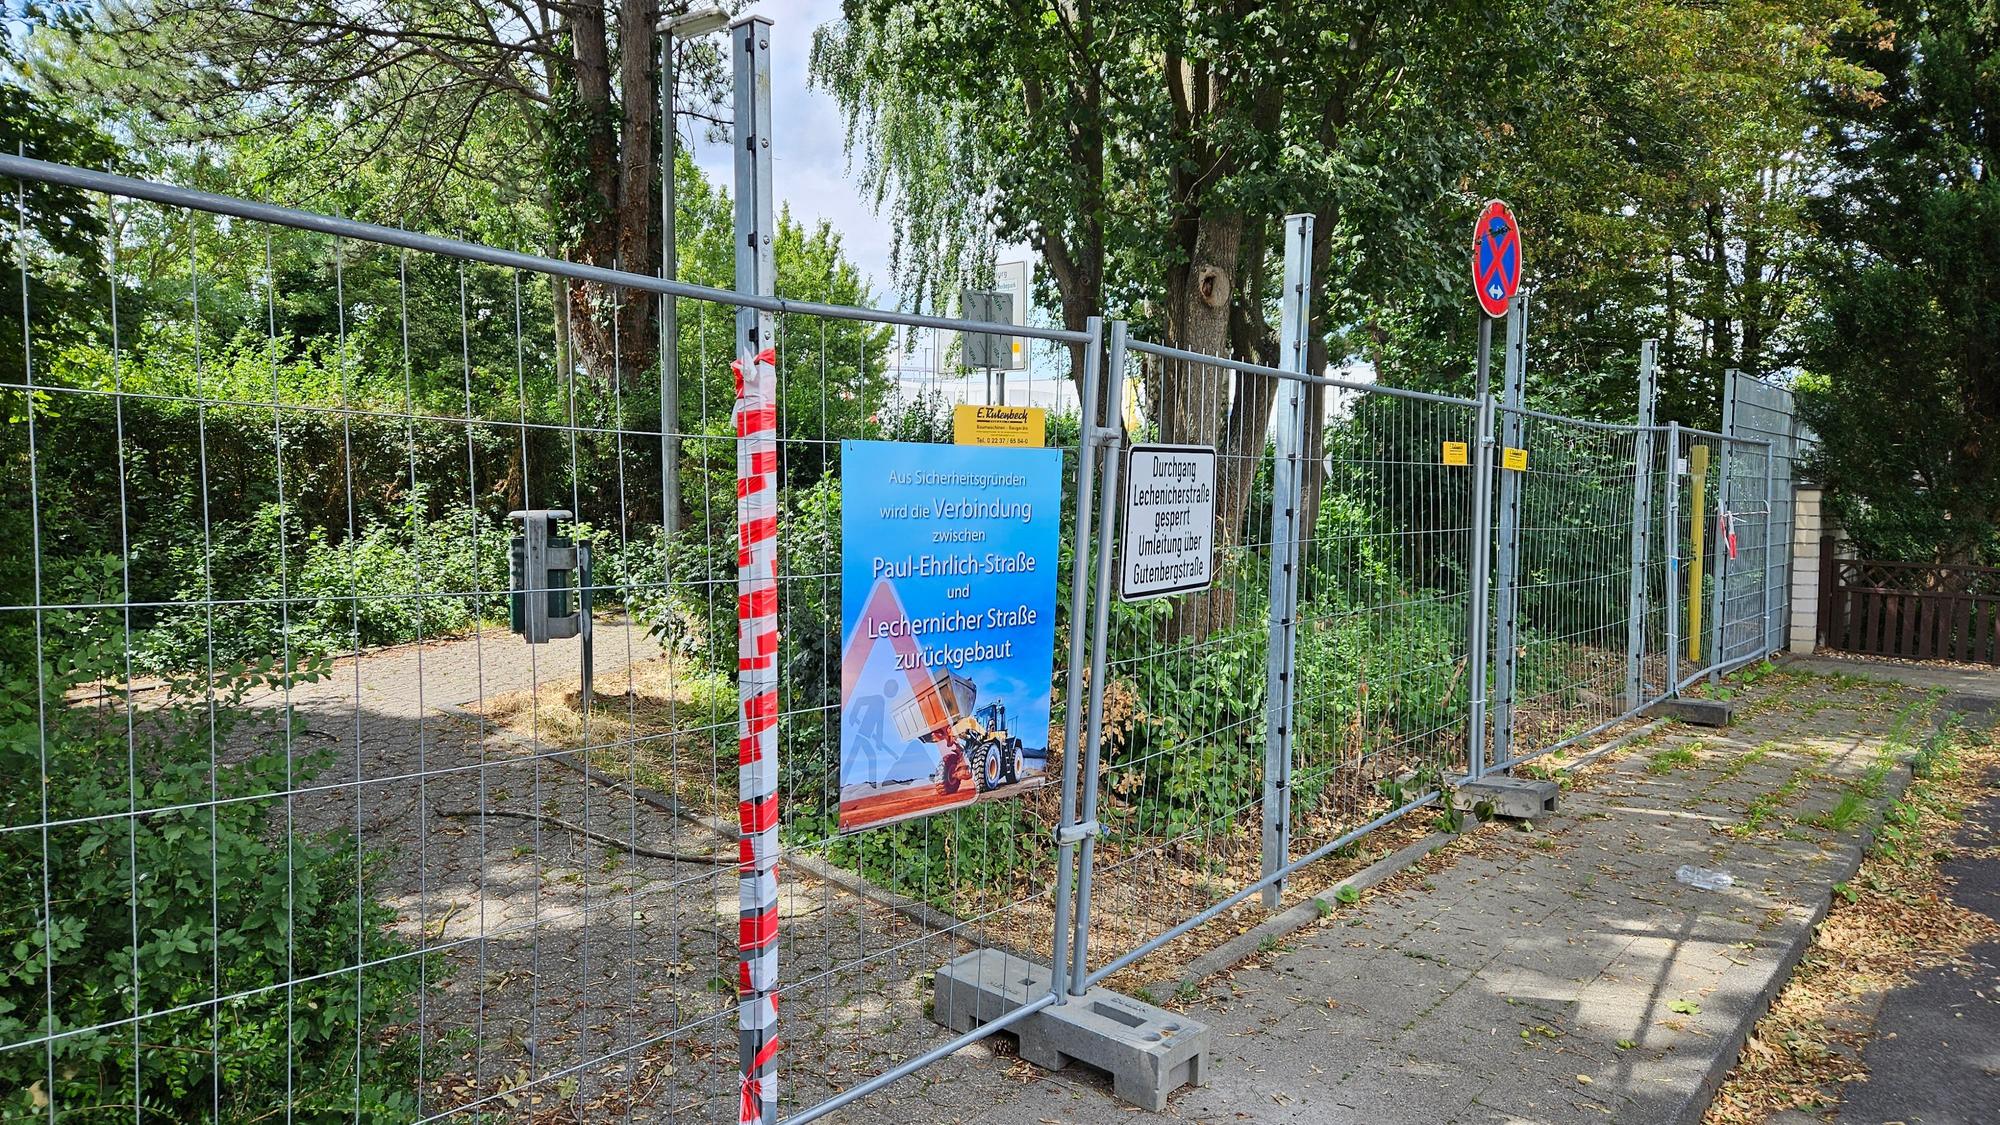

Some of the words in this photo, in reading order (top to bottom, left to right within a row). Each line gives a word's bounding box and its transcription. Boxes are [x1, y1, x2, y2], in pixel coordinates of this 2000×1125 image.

[986, 407, 1028, 423] Rutenbeck
[889, 470, 912, 485] Aus
[915, 470, 1026, 489] Sicherheitsgründen
[1152, 456, 1196, 482] Durchgang
[1134, 483, 1210, 506] Lechenicherstraße
[880, 504, 908, 519] wird
[912, 504, 930, 518] die
[933, 498, 1032, 523] Verbindung
[1155, 506, 1190, 532] gesperrt
[932, 528, 986, 542] zwischen
[1138, 534, 1182, 558] Umleitung
[1184, 532, 1202, 552] über
[873, 552, 1036, 578] Paul-Ehrlich-Straße
[1134, 556, 1204, 584] Gutenbergstraße
[947, 584, 970, 598] und
[868, 608, 983, 639] Lechernicher
[987, 605, 1037, 628] Straße
